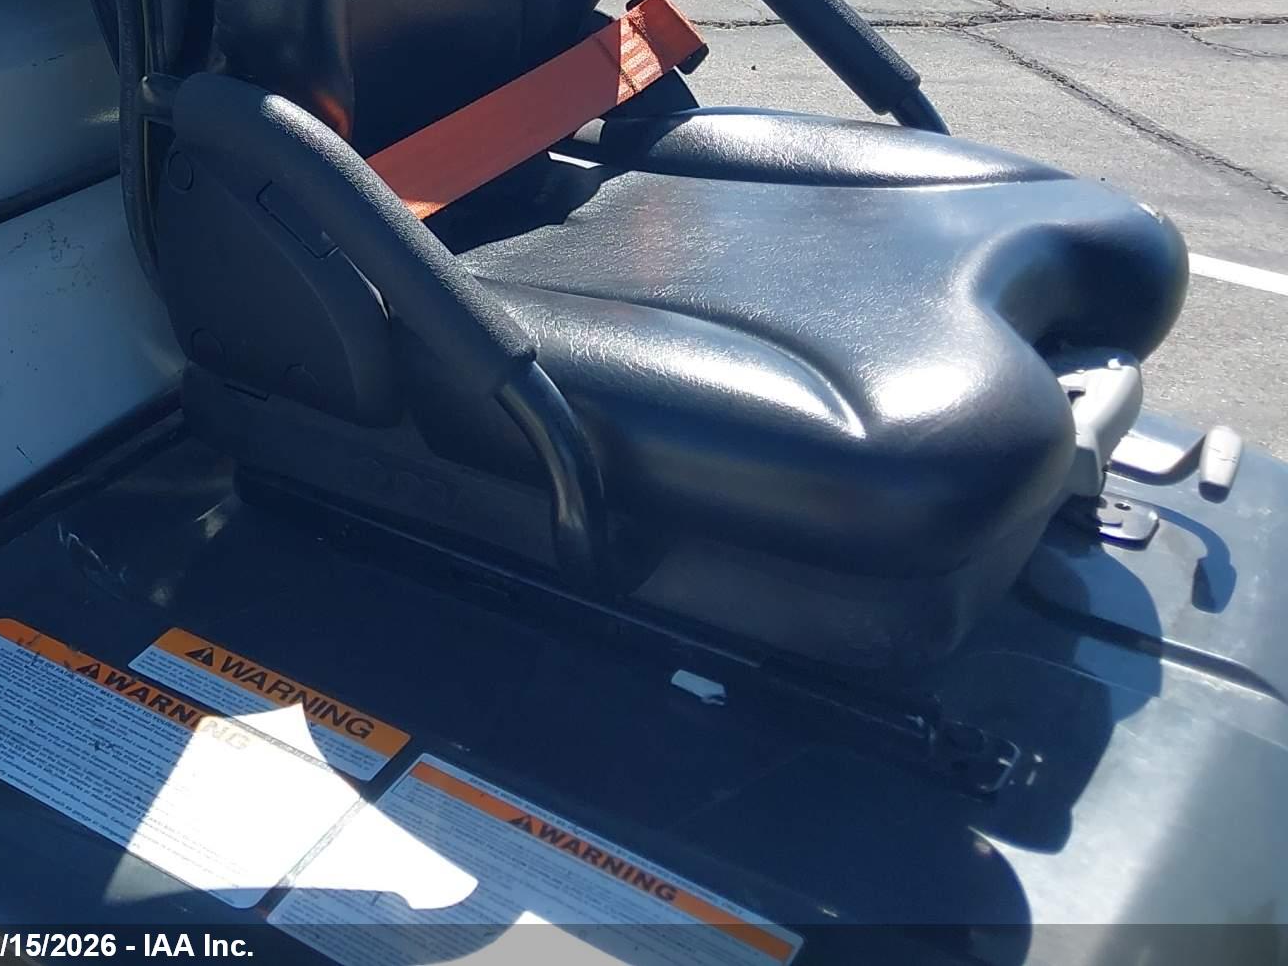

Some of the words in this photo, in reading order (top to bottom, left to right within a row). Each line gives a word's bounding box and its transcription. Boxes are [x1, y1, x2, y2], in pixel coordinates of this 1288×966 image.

[104, 670, 251, 751] WARNING
[221, 655, 375, 740] WARNING
[532, 822, 678, 903] WARNING
